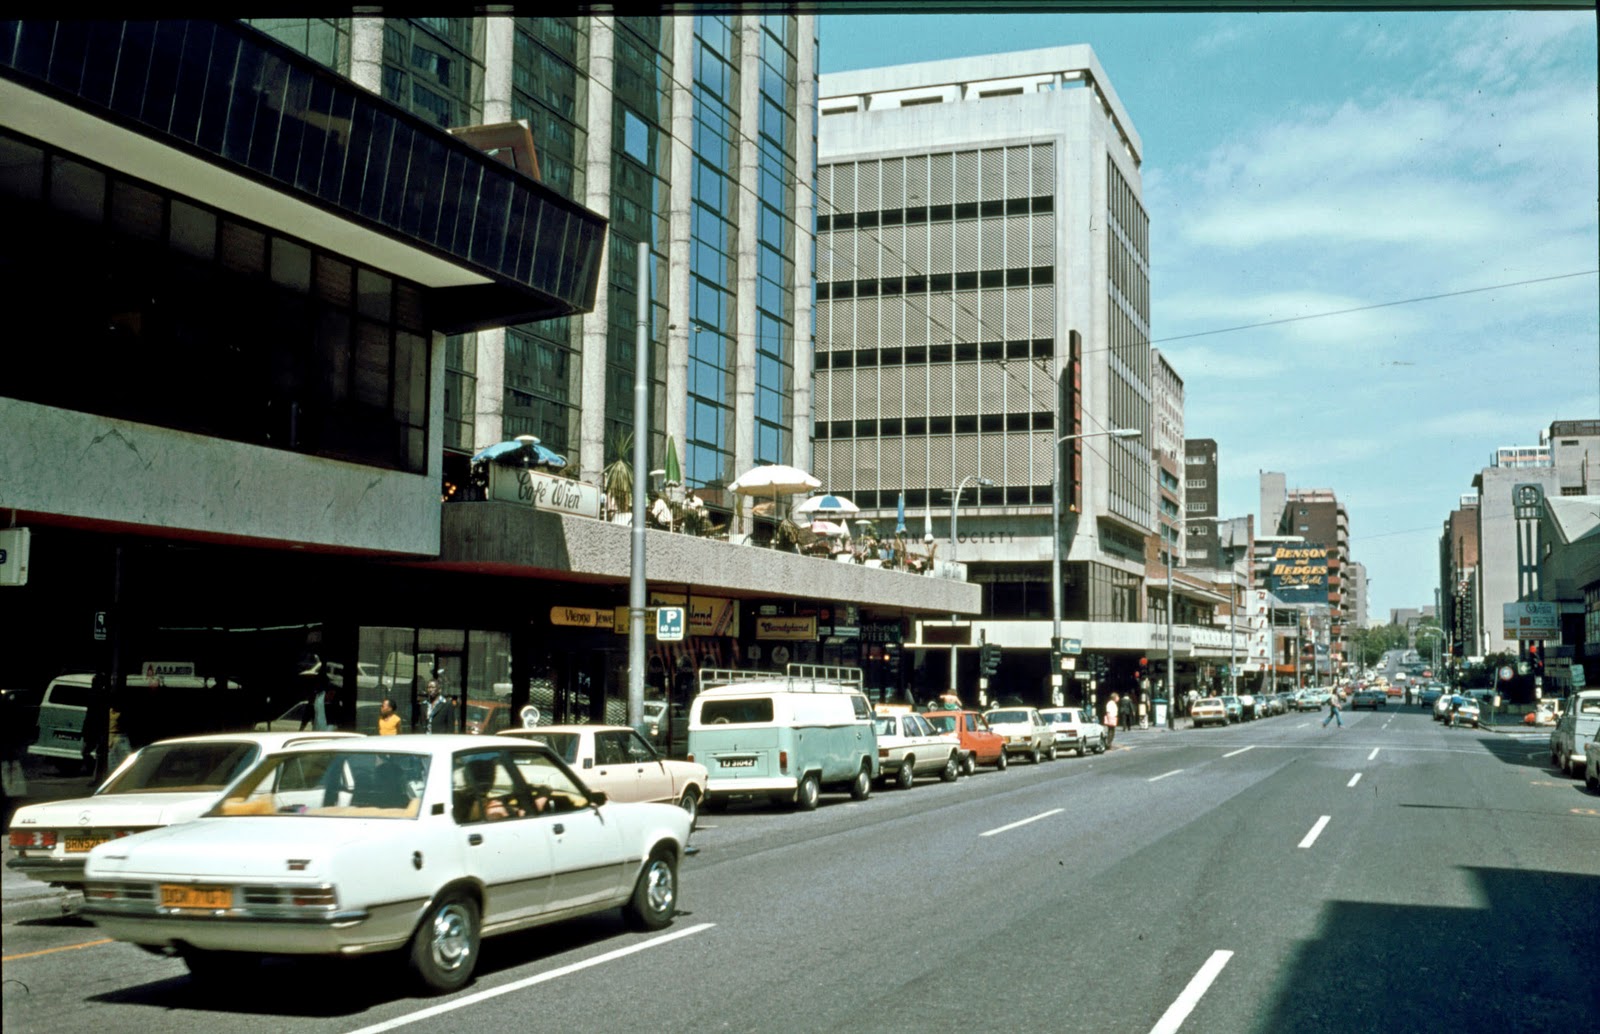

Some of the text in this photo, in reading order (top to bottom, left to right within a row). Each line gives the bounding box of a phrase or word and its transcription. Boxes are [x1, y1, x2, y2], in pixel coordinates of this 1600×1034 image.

[516, 471, 580, 509] Café Wien
[1275, 547, 1328, 559] BENSON
[1273, 564, 1328, 575] HEDGES
[565, 608, 591, 624] Vienna
[666, 611, 678, 624] P
